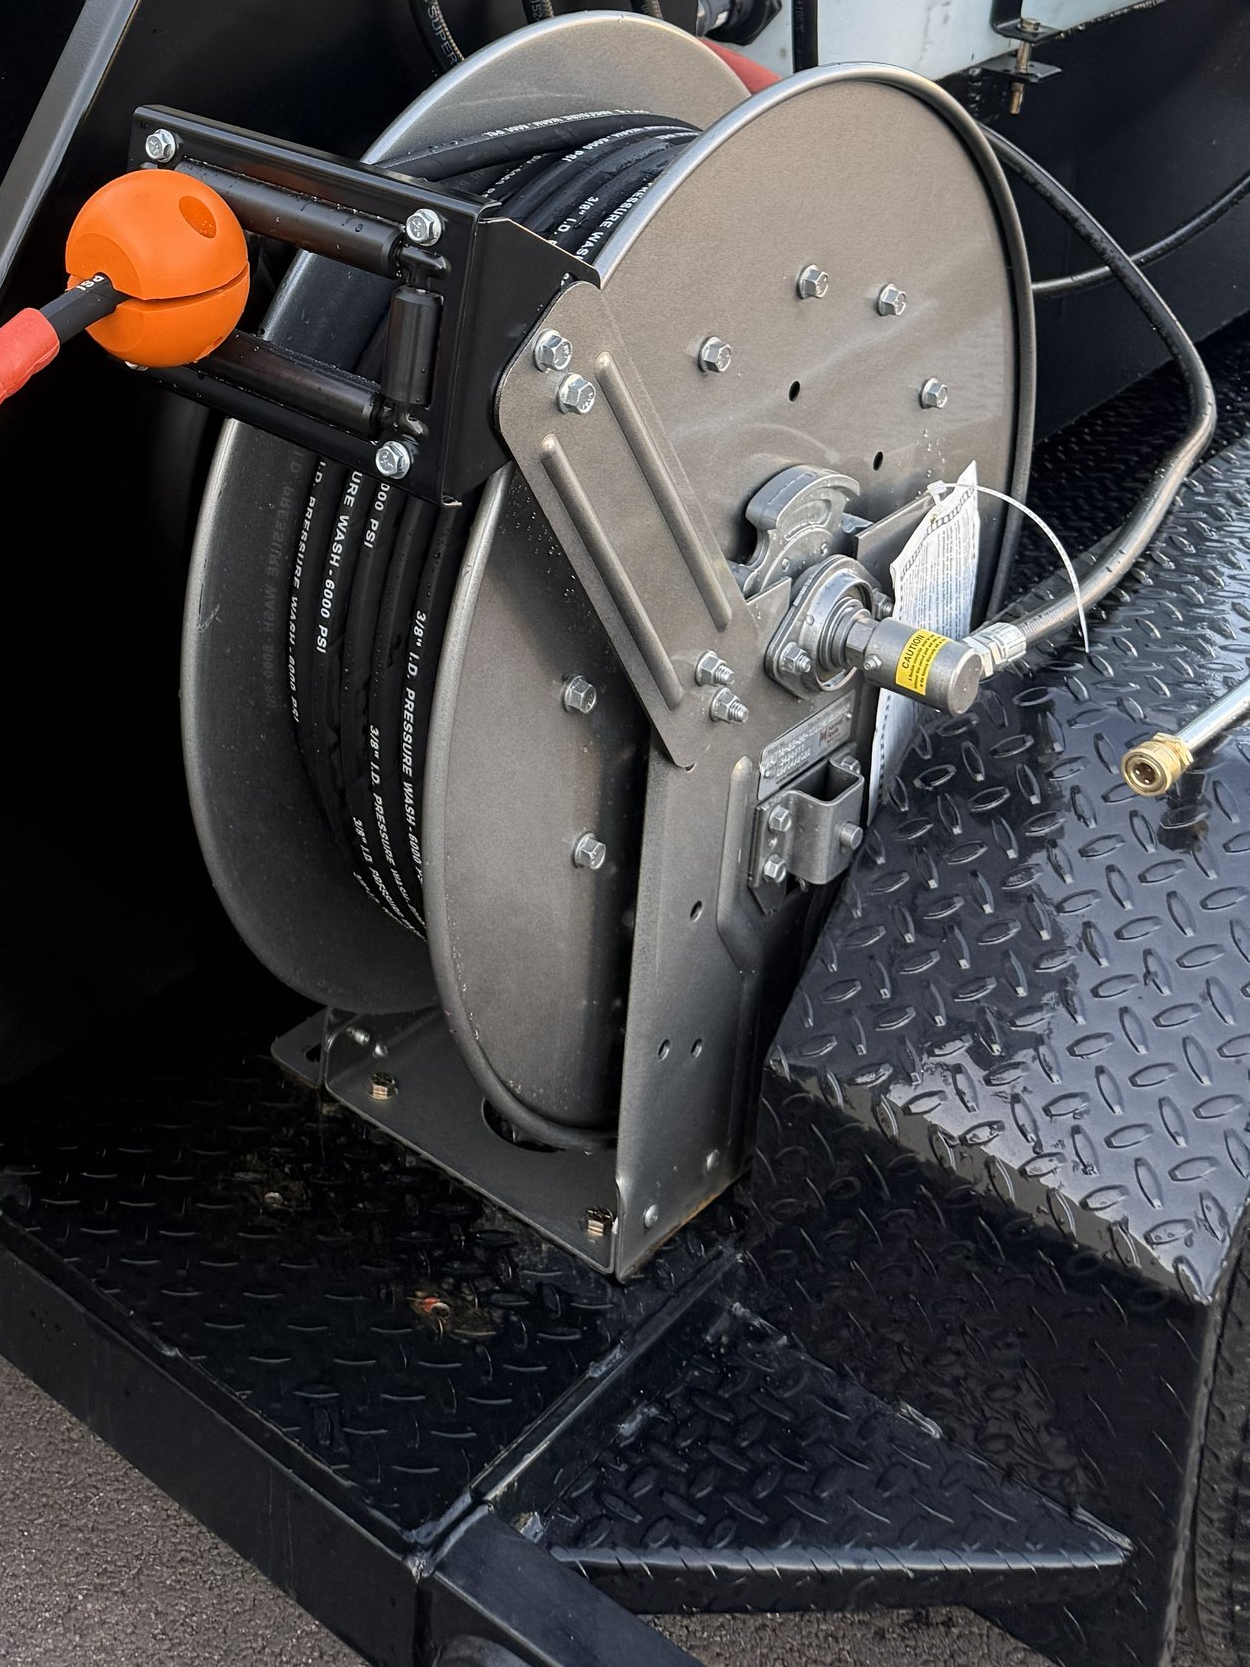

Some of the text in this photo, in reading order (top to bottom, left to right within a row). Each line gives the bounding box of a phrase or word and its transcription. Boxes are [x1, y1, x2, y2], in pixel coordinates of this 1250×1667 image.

[427, 5, 458, 66] SUPER
[578, 196, 600, 215] 3/8"
[76, 275, 105, 291] PSI
[293, 496, 316, 589] PRESSURE
[329, 515, 350, 567] WASH
[363, 518, 379, 549] PSI
[320, 579, 335, 619] 6000
[316, 624, 329, 654] PSI
[413, 610, 427, 647] 3/8"
[406, 651, 420, 679] I.D.
[901, 634, 924, 669] CAUTION
[370, 724, 380, 759] 3/8"
[402, 687, 416, 777] PRESSURE
[370, 761, 381, 786] I.D.
[403, 781, 416, 826] WASH
[373, 792, 396, 867] PRESSURE
[408, 832, 422, 864] 6000
